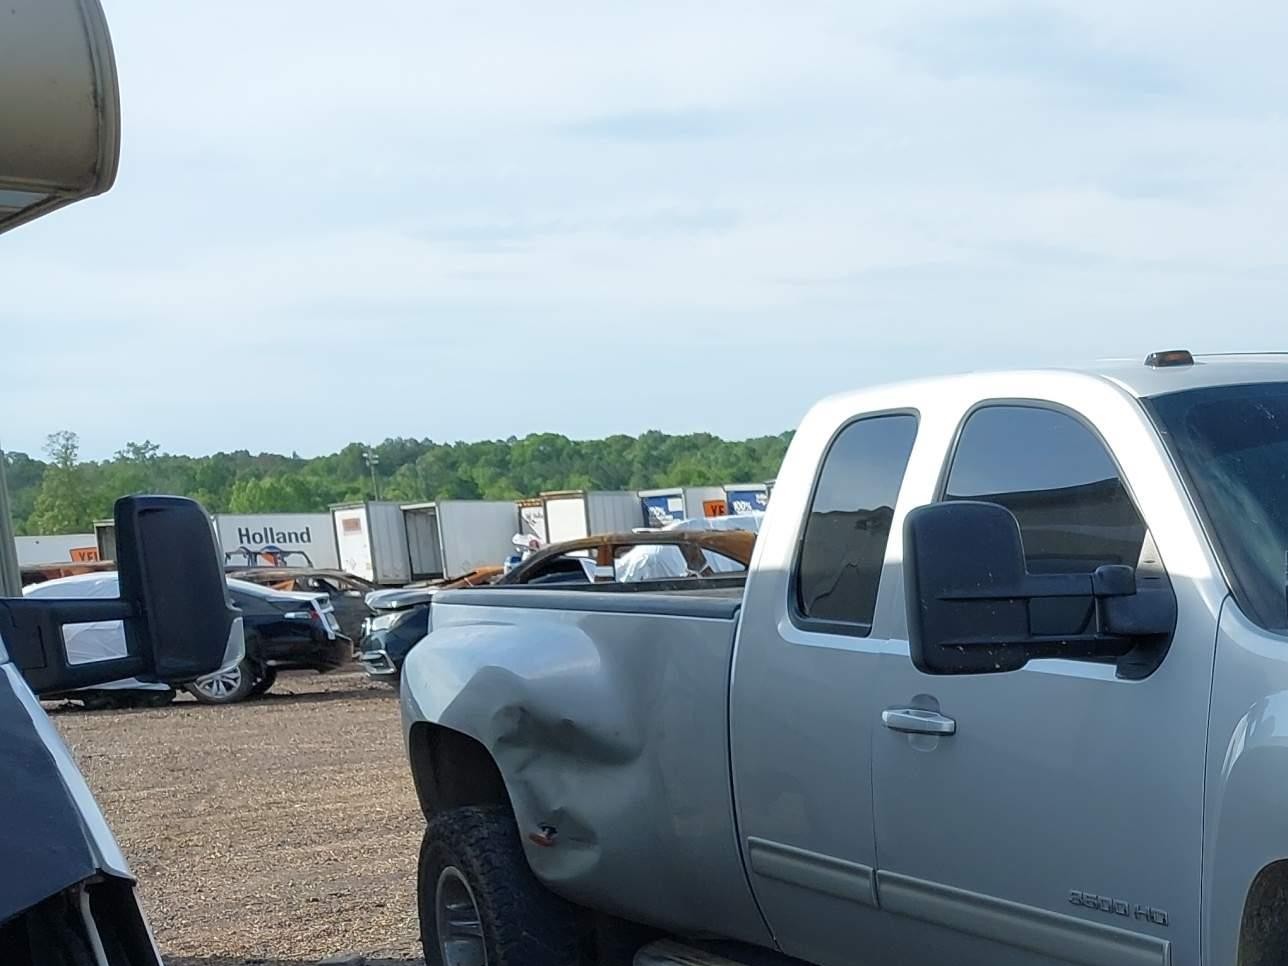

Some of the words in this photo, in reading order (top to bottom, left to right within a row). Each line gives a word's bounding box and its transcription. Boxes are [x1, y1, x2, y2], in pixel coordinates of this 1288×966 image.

[237, 526, 312, 545] Holland
[1068, 889, 1130, 917] 3500
[1134, 903, 1169, 927] HD
